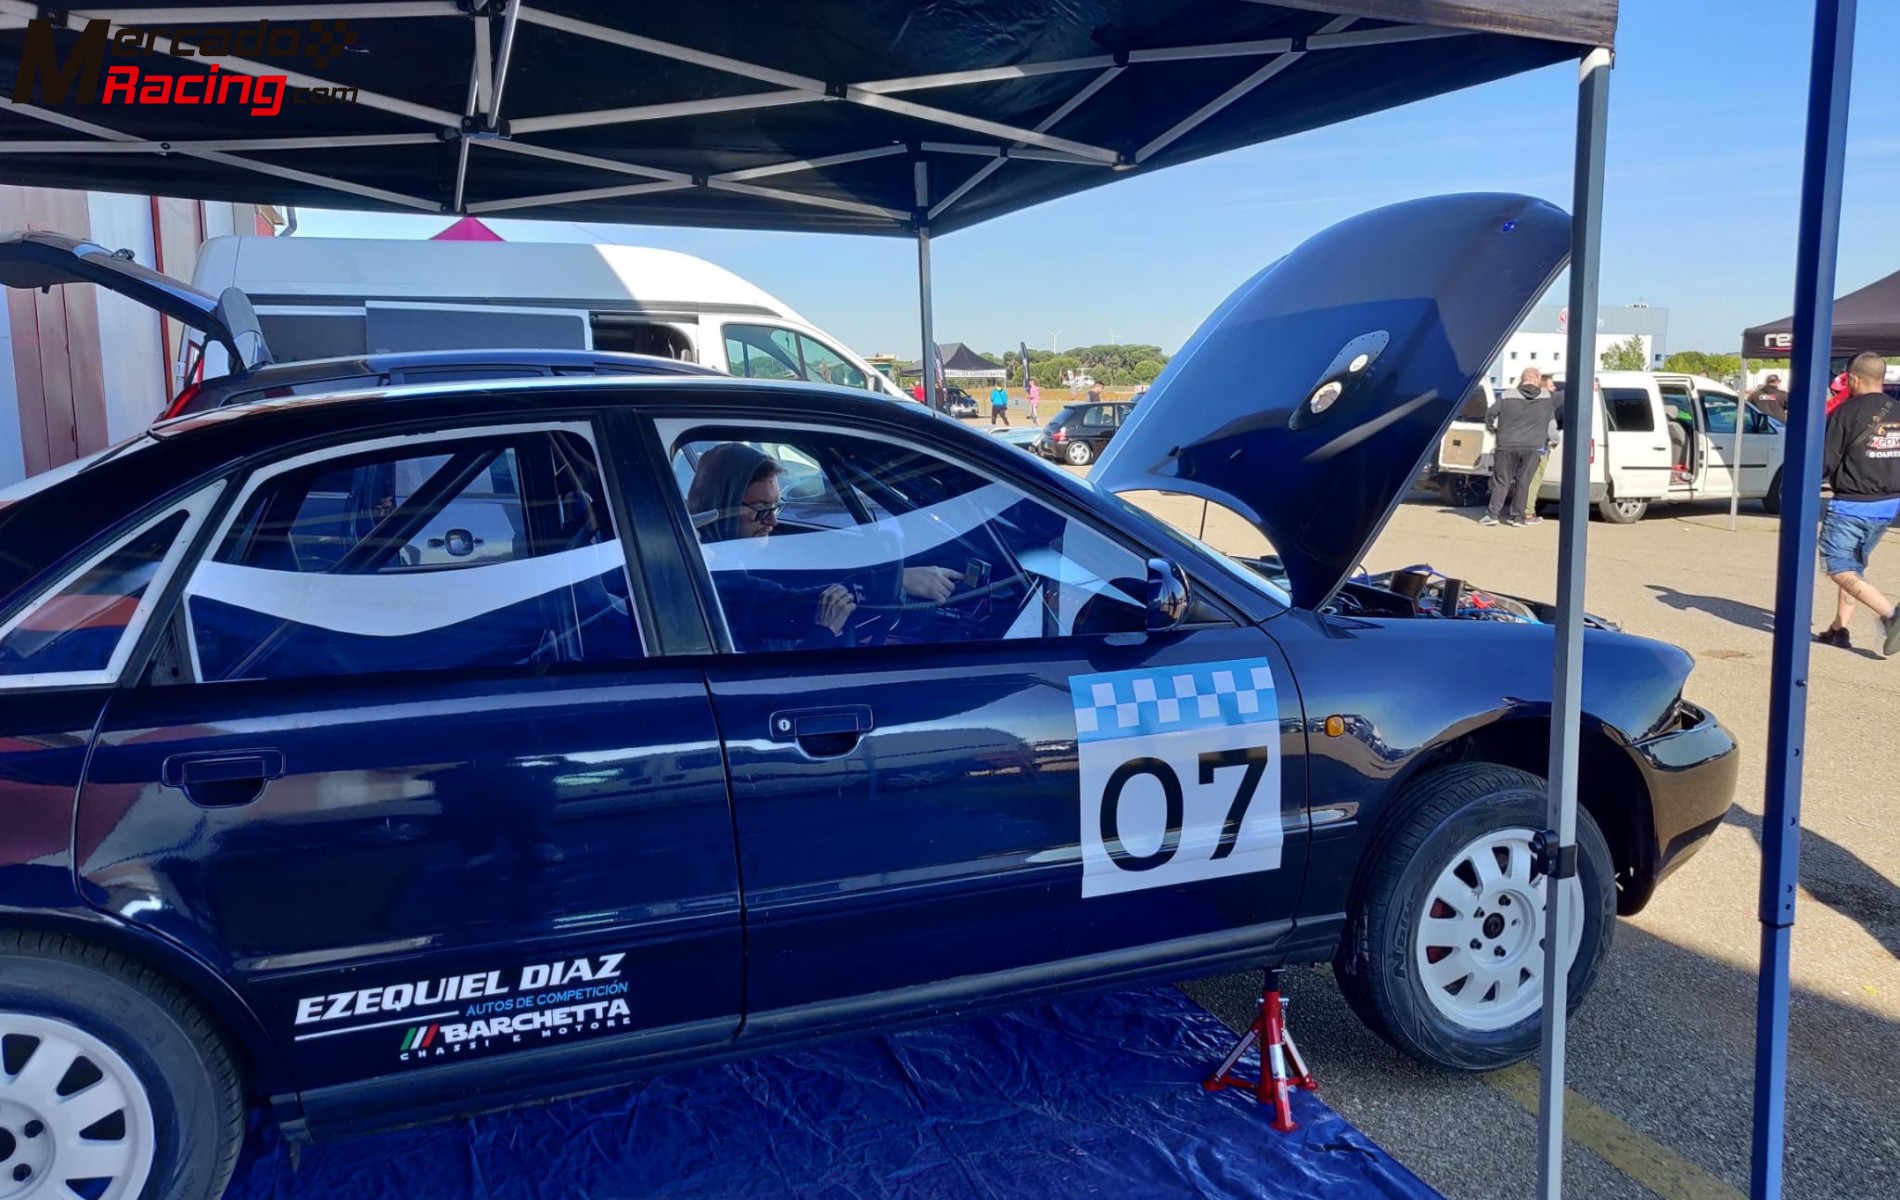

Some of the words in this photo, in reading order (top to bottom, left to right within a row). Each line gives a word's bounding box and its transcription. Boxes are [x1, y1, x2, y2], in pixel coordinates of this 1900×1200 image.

[1764, 332, 1792, 348] re
[1100, 746, 1268, 872] 07
[294, 970, 509, 1025] EZEQUIEL
[518, 952, 627, 991] DIAZ
[466, 997, 514, 1017] AUTOS
[515, 996, 534, 1009] DE
[536, 979, 628, 1006] COMPETICIÓN
[400, 1040, 490, 1061] CHASSI
[513, 1034, 521, 1043] E
[541, 1017, 631, 1039] MOTORE
[440, 998, 631, 1044] BARCHETTA
